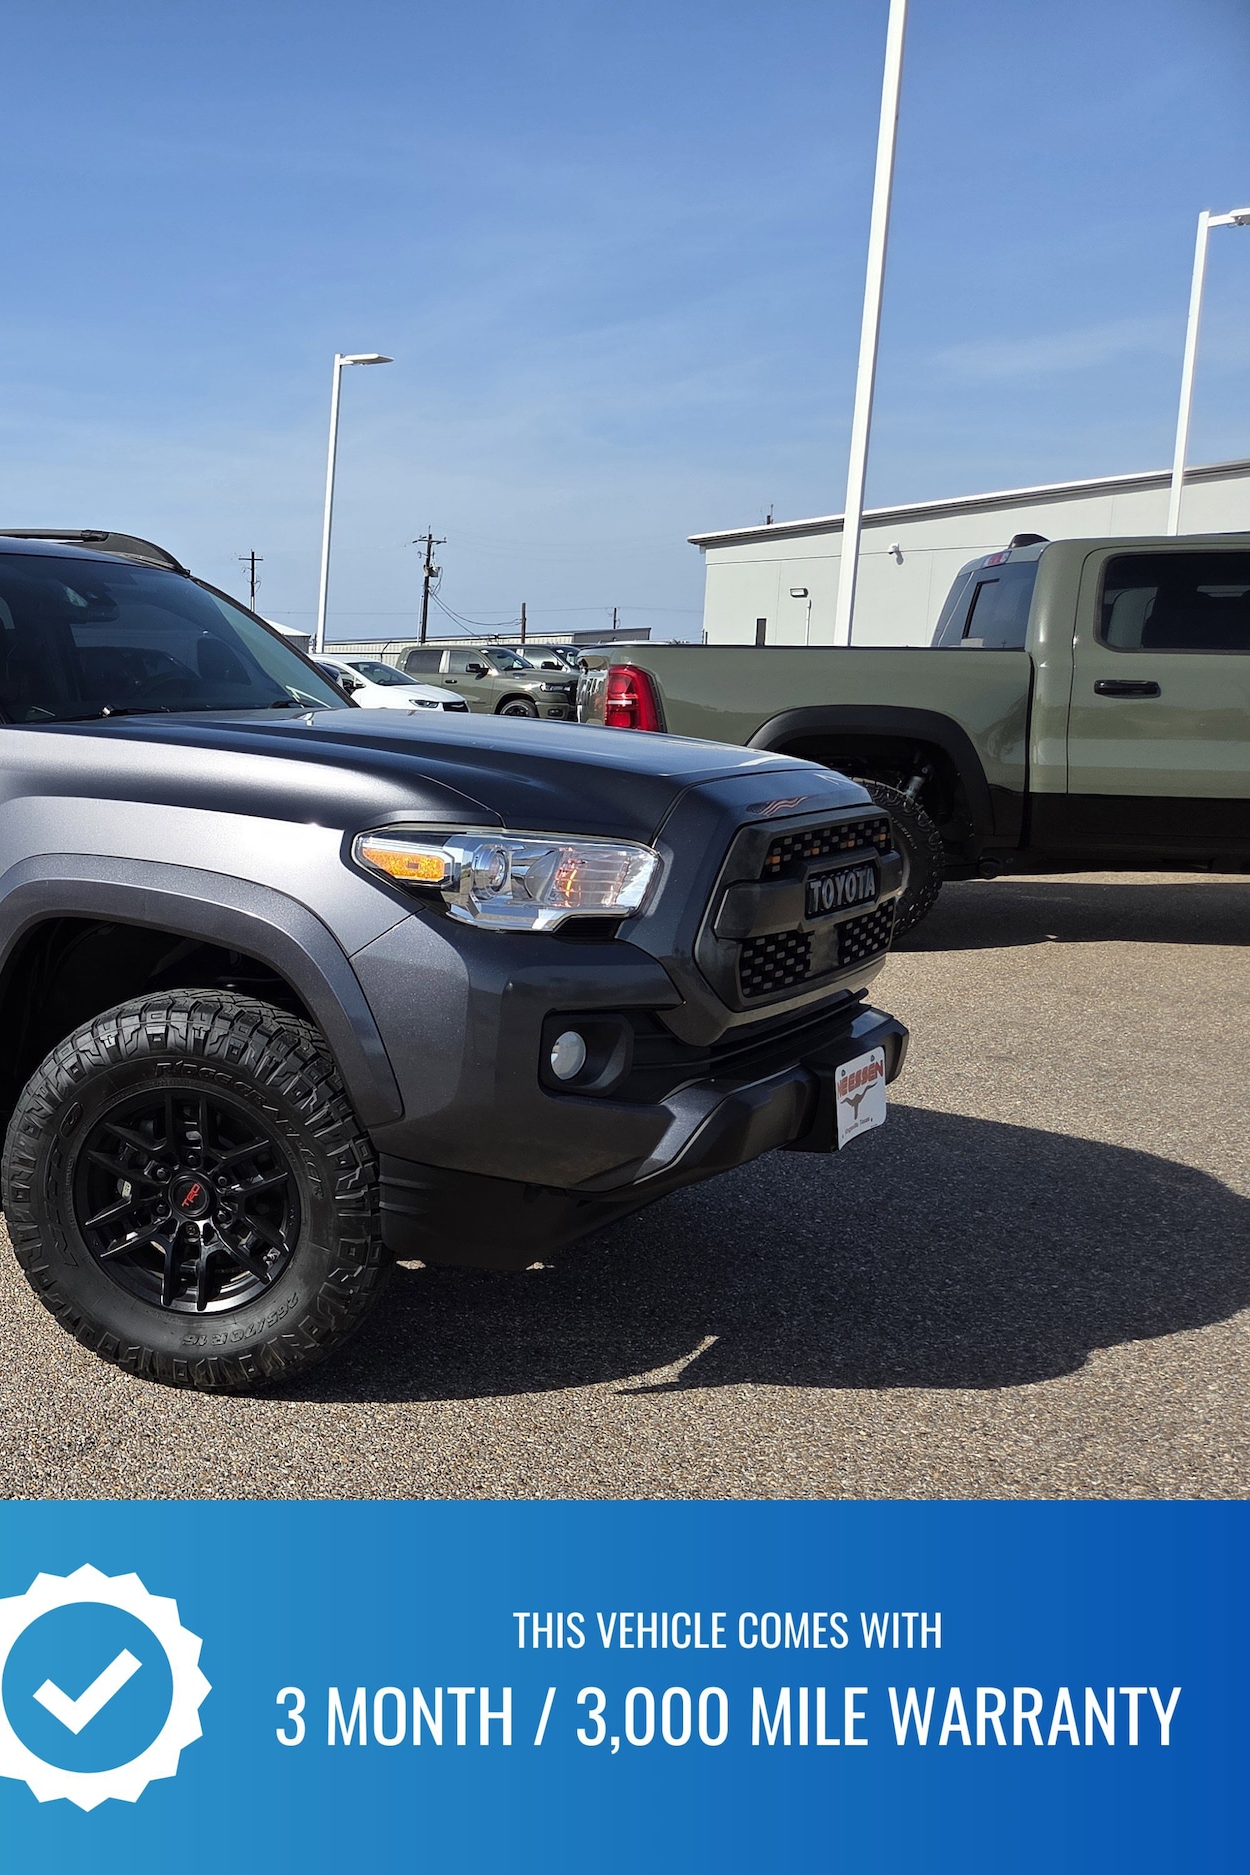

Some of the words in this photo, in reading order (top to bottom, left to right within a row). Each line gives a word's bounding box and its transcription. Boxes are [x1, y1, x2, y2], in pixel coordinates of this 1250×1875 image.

[808, 866, 876, 913] TOYOTA
[837, 1060, 883, 1098] NEESSEN
[181, 1183, 200, 1207] TRD
